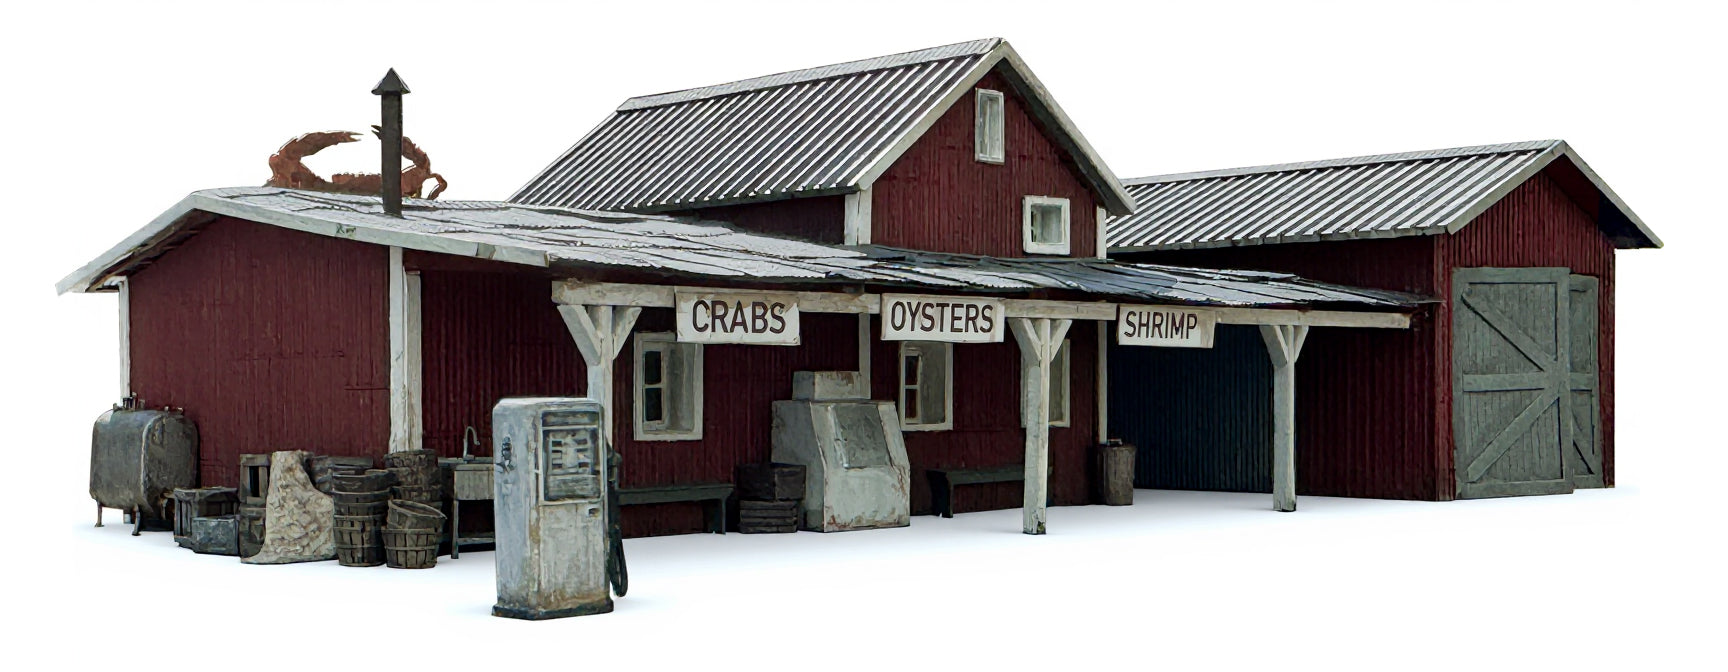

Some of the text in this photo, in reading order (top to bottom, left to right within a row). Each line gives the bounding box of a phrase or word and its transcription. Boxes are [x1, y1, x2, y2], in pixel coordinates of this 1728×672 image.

[693, 300, 786, 334] CRABS
[891, 301, 994, 333] OYSTERS
[1124, 311, 1198, 339] SHRIMP
